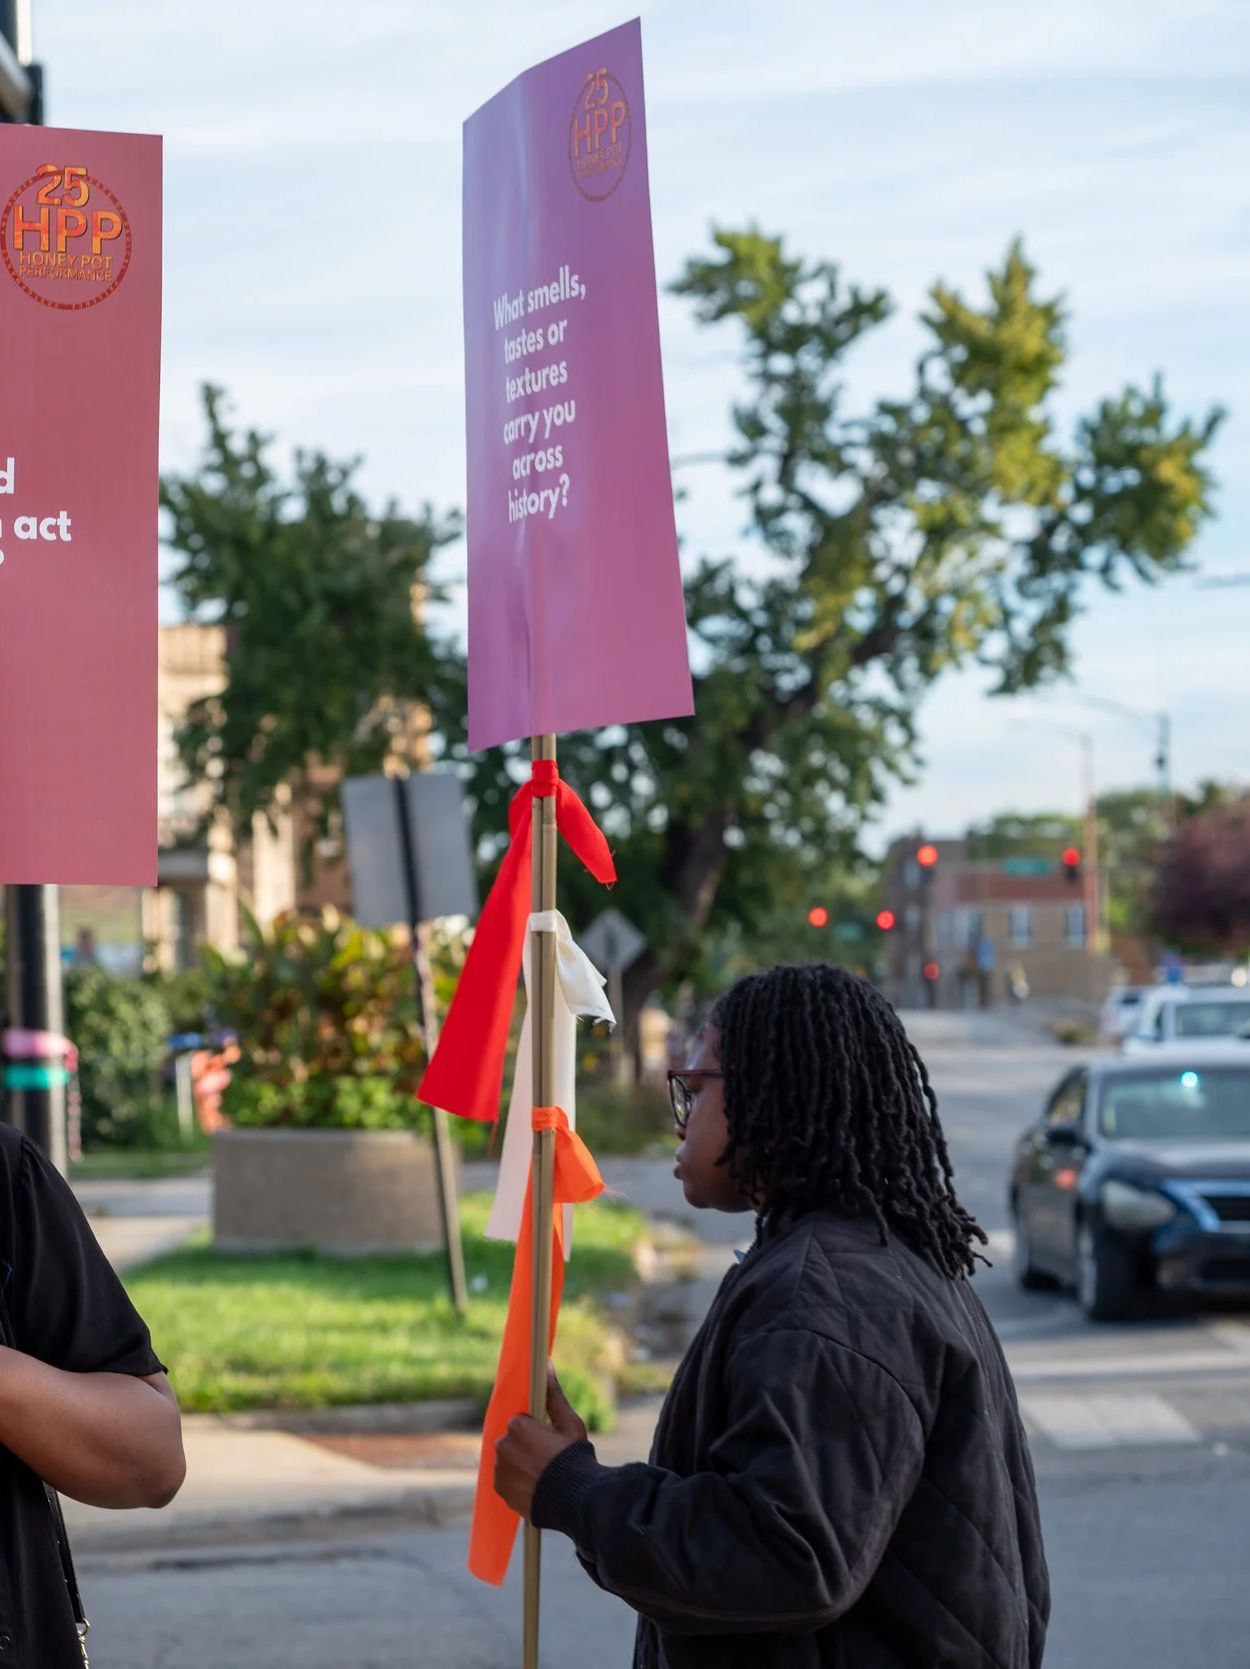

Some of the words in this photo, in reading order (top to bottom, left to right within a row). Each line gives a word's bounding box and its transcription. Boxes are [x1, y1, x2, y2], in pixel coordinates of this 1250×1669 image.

[584, 67, 610, 111] 25
[573, 99, 627, 158] HPP
[36, 163, 91, 207] 25
[13, 204, 124, 256] HPP
[19, 250, 78, 268] HONEY
[80, 254, 113, 271] POT
[493, 289, 525, 331] What
[527, 265, 587, 313] smells,
[504, 327, 544, 364] tastes
[547, 319, 568, 346] or
[505, 360, 568, 402] textures
[503, 410, 540, 444] carry
[542, 400, 576, 439] you
[512, 445, 563, 480] across
[508, 472, 571, 524] history?
[13, 511, 72, 541] act
